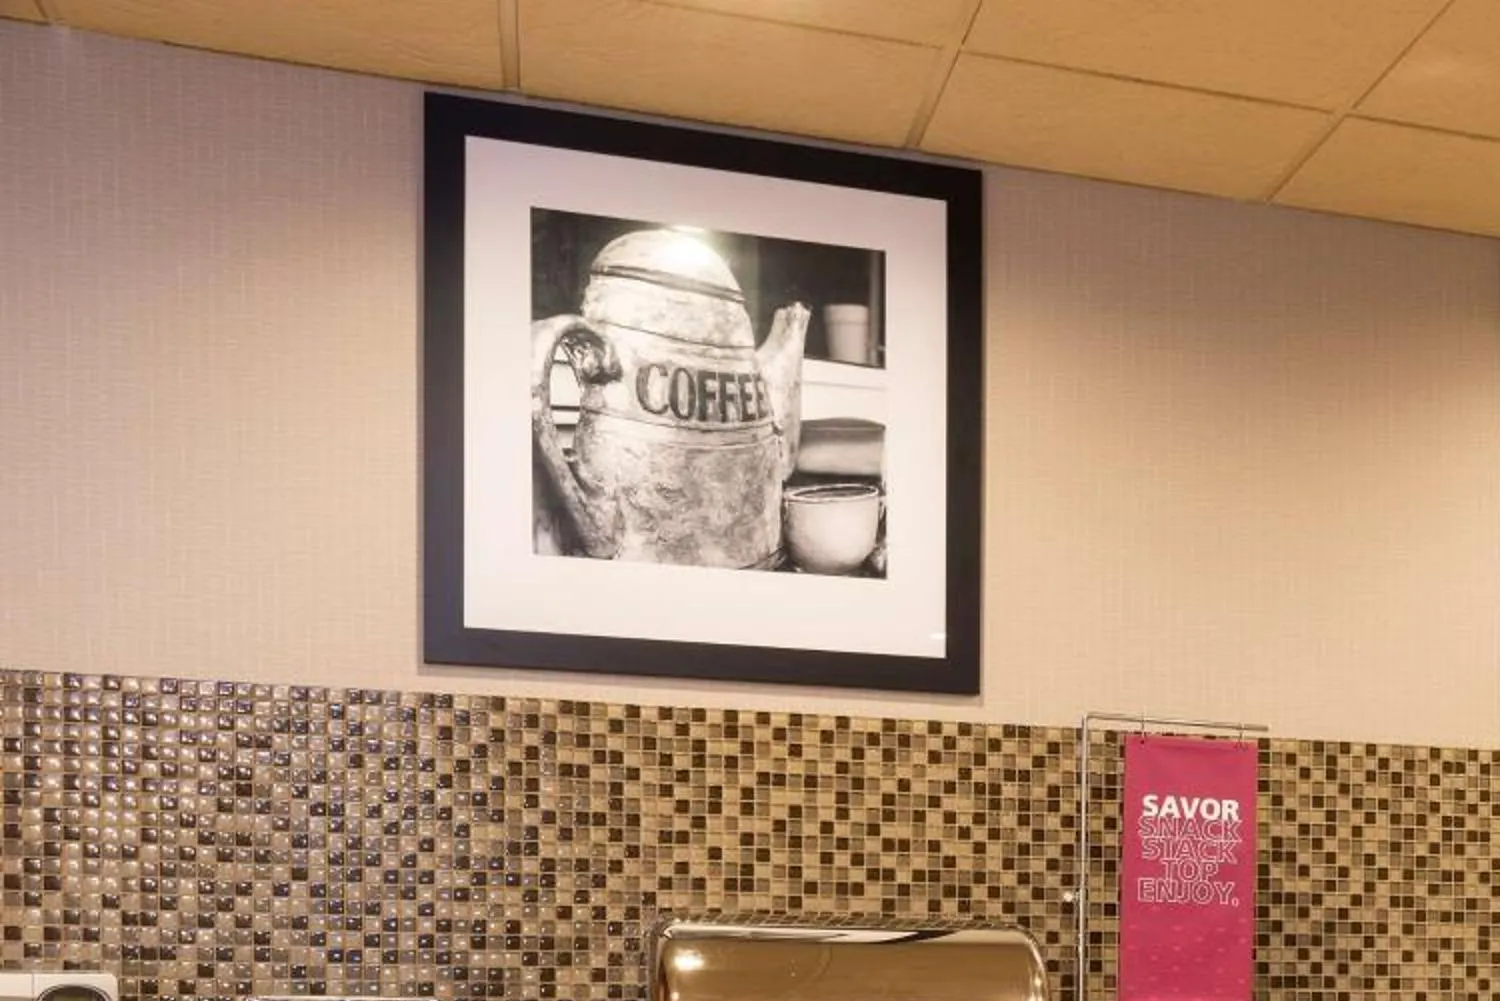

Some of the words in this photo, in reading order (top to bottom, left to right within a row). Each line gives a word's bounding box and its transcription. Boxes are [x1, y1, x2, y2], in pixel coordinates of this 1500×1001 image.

[635, 364, 769, 422] COFFEE
[1142, 794, 1240, 821] SAVOR
[1138, 815, 1242, 842] SNACK
[1141, 837, 1238, 864] STACK
[1161, 859, 1219, 882] TOP
[1137, 877, 1240, 907] ENJOY.
